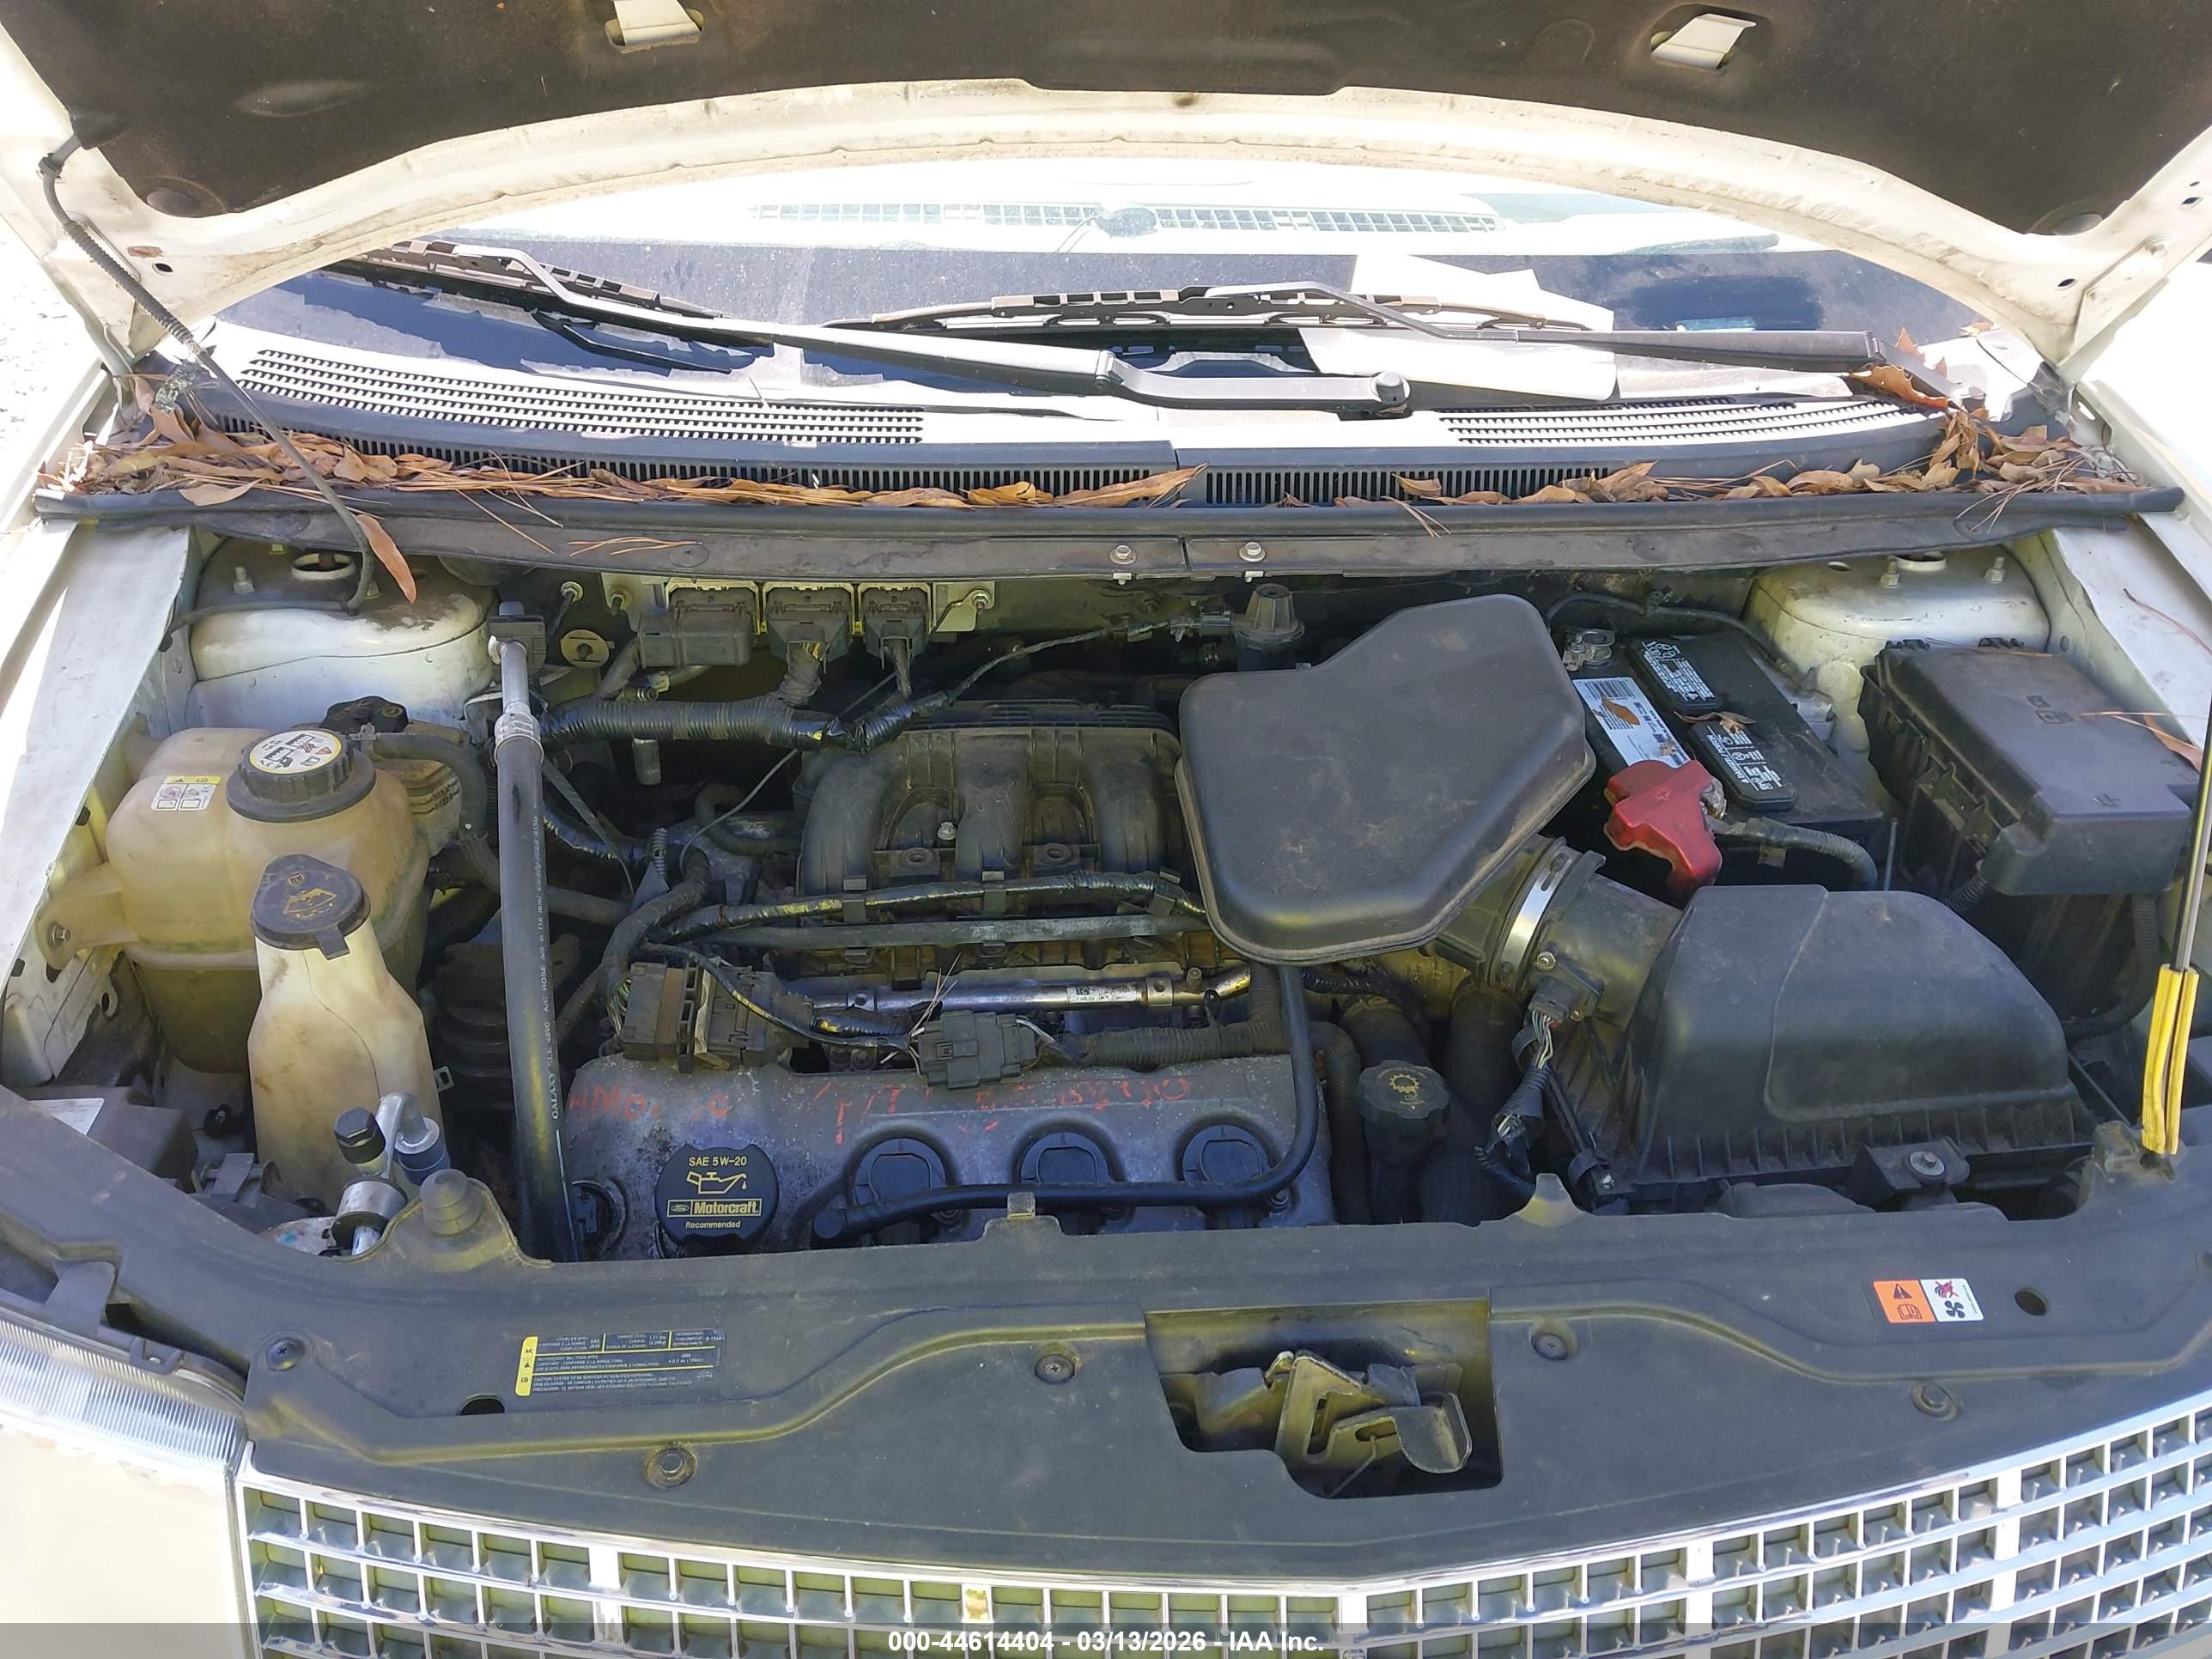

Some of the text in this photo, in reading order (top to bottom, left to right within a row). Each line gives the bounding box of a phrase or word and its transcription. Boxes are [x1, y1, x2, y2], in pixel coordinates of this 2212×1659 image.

[539, 964, 548, 991] HOSE
[548, 1071, 559, 1120] GALAXY
[689, 1156, 748, 1166] SAE 5W-20
[694, 1200, 759, 1215] Motorcraft
[685, 1219, 741, 1229] Recommended
